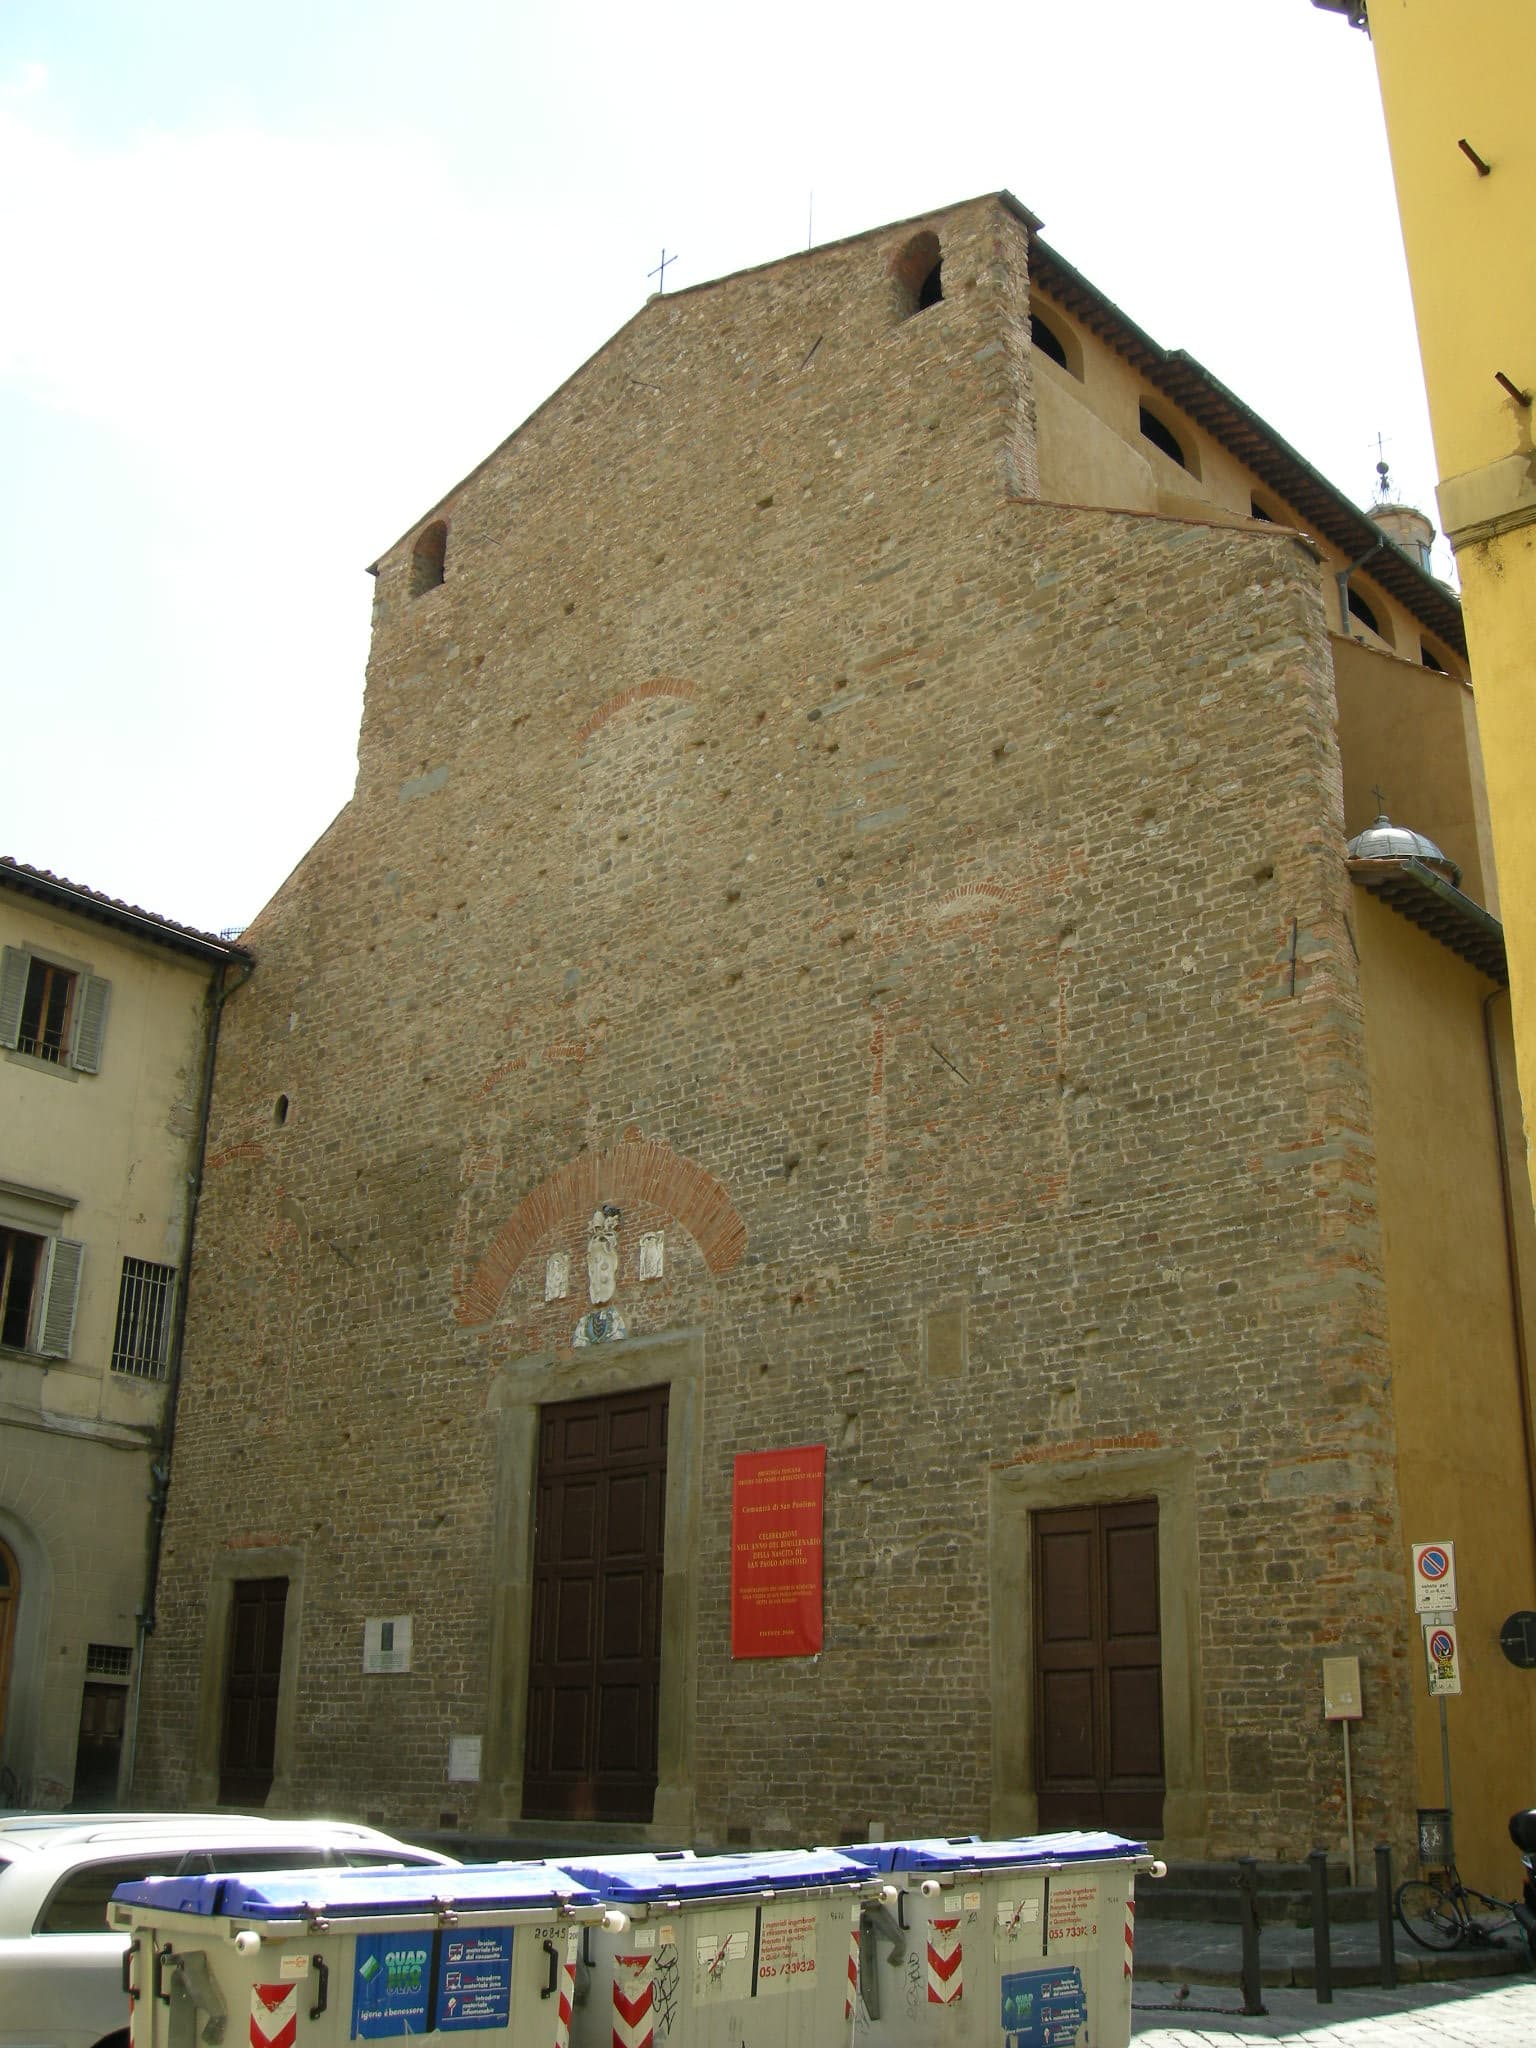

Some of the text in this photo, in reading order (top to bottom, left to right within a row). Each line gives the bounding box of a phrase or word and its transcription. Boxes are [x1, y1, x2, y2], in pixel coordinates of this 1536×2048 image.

[1049, 1929, 1063, 1939] 055
[385, 1950, 427, 1967] QUAD
[760, 1966, 776, 1977] 055
